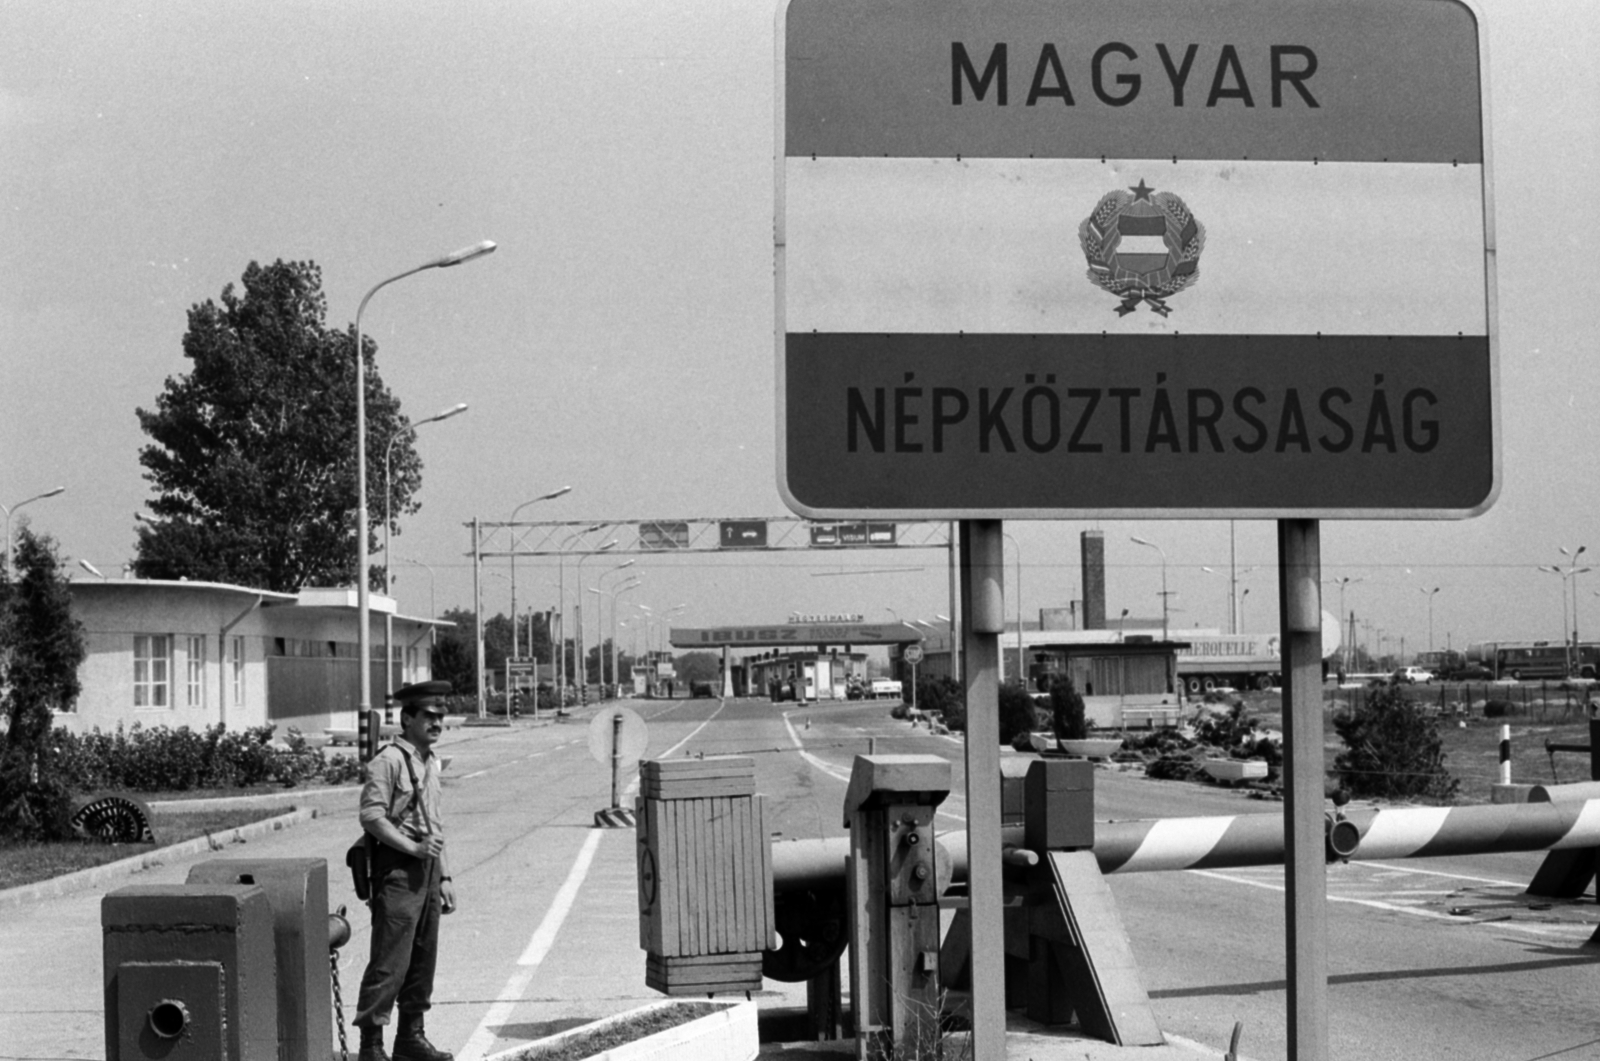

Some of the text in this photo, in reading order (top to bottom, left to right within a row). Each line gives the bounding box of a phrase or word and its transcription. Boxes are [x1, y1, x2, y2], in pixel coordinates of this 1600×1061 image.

[951, 42, 1320, 108] MAGYAR
[848, 372, 1439, 453] NÉPKÖZTÁRSASÁG
[701, 629, 797, 642] IBUSZ
